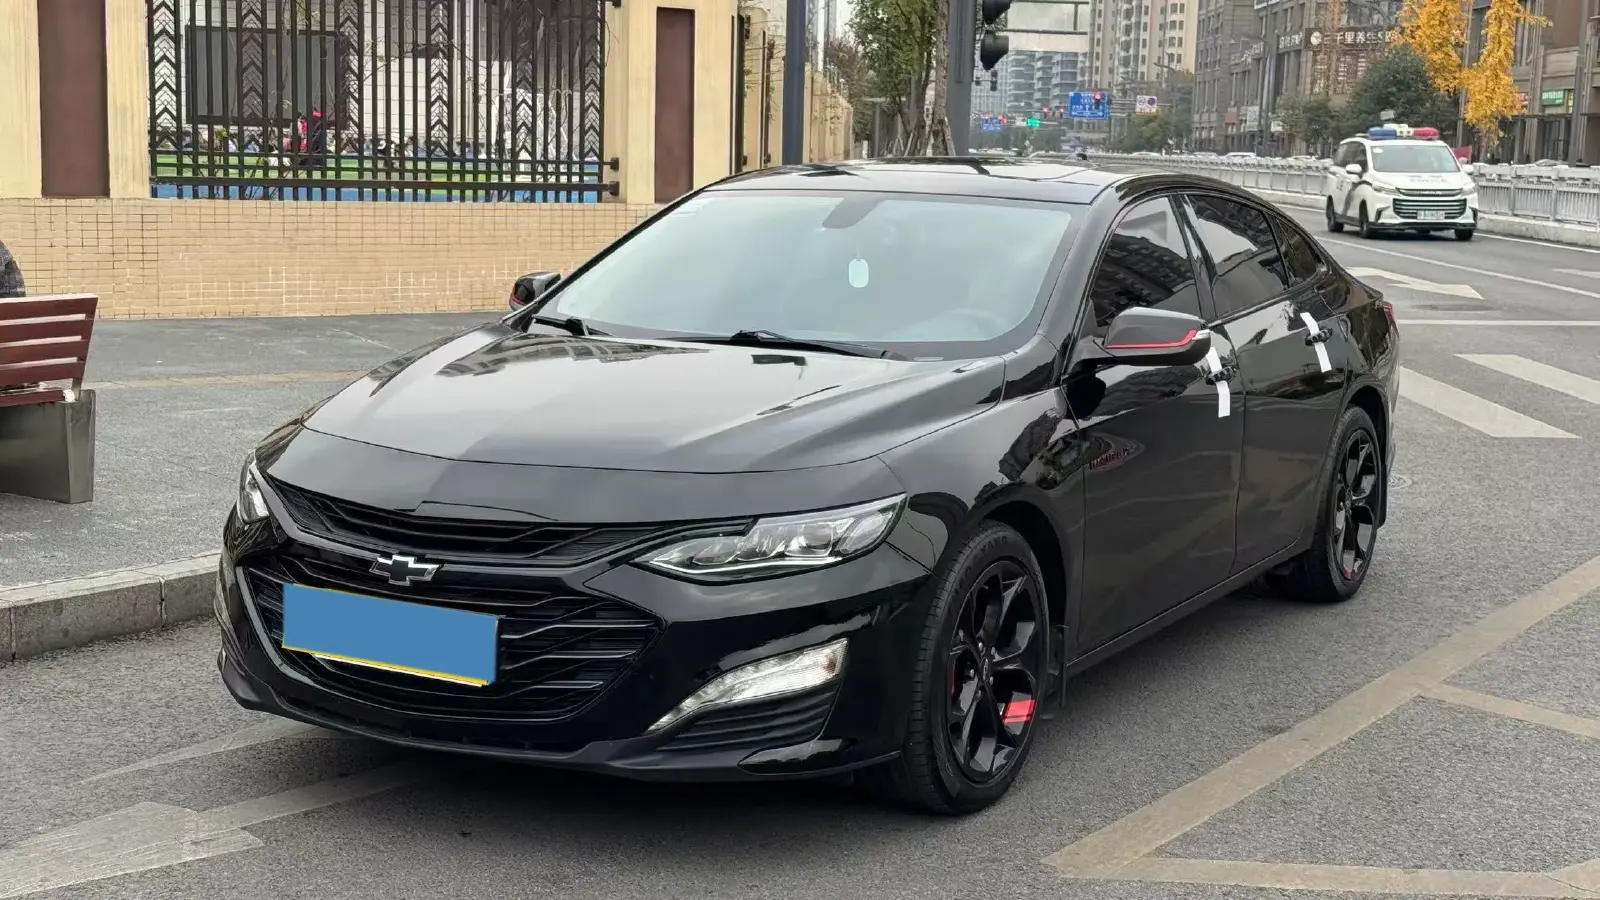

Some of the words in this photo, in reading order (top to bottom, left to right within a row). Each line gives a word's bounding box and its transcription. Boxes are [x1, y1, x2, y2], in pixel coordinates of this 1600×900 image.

[1323, 31, 1394, 45] 三千里养生SP
